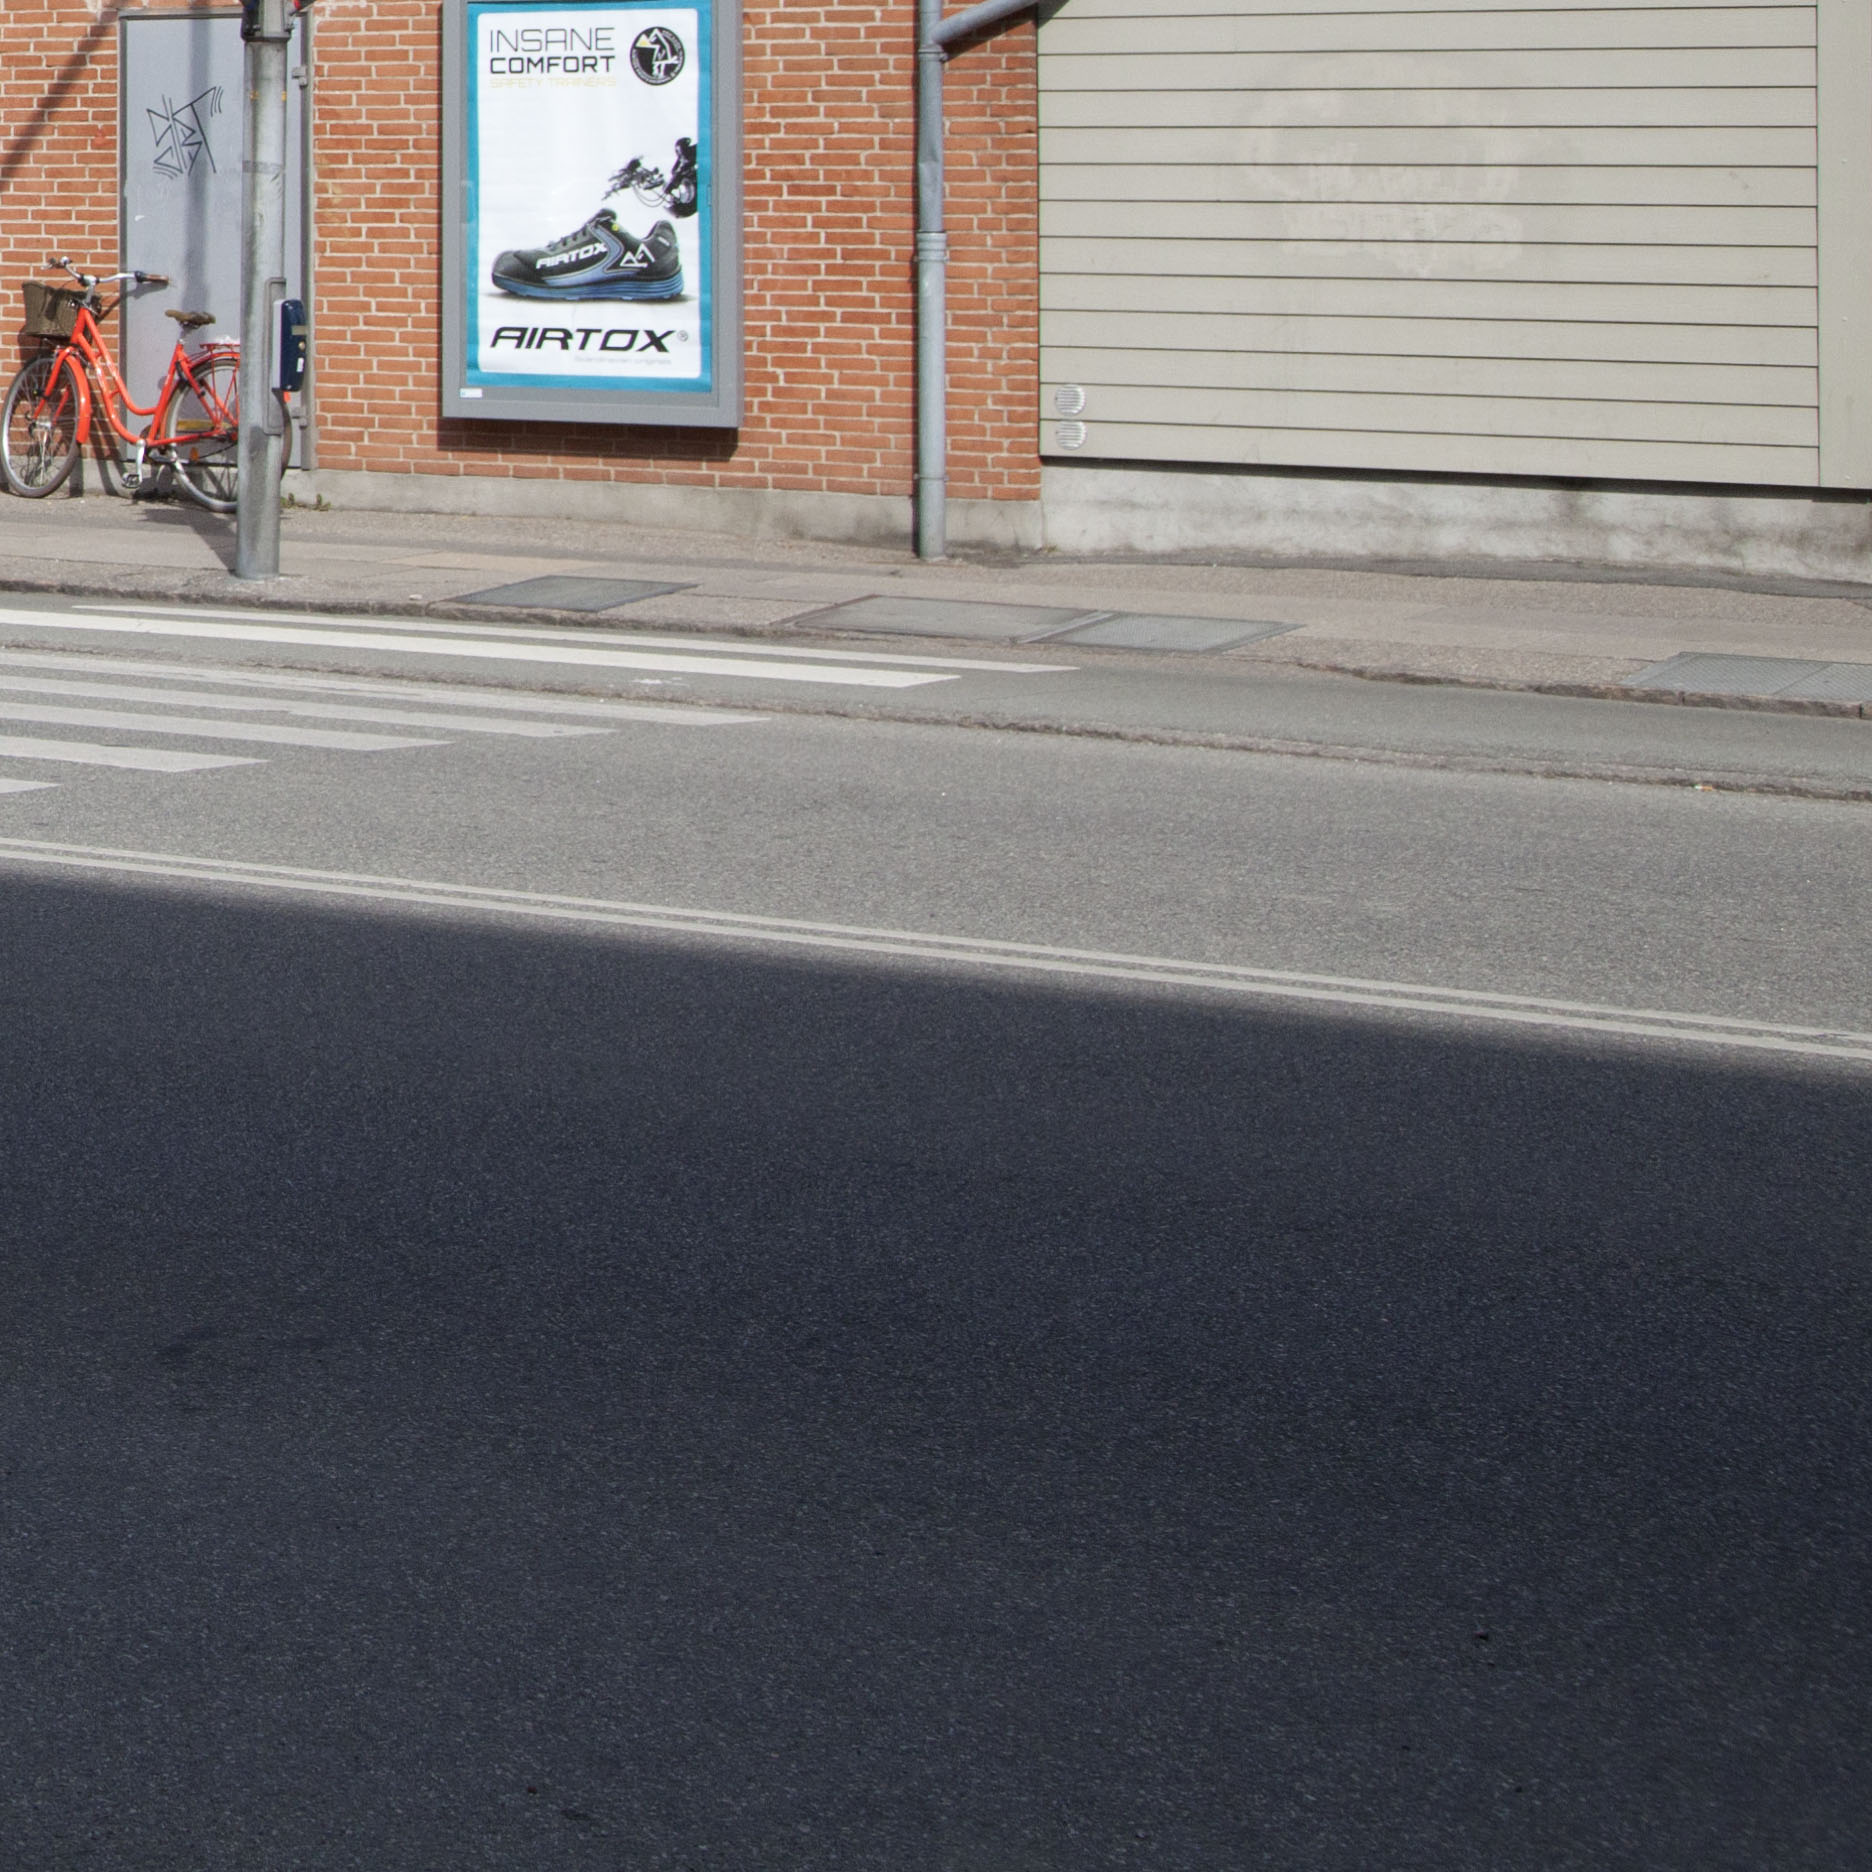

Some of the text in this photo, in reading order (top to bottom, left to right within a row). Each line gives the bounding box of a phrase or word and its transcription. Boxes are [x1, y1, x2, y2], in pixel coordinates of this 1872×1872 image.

[489, 27, 615, 53] INSANE
[490, 55, 615, 74] COMFORT
[536, 242, 609, 270] AIRTOX
